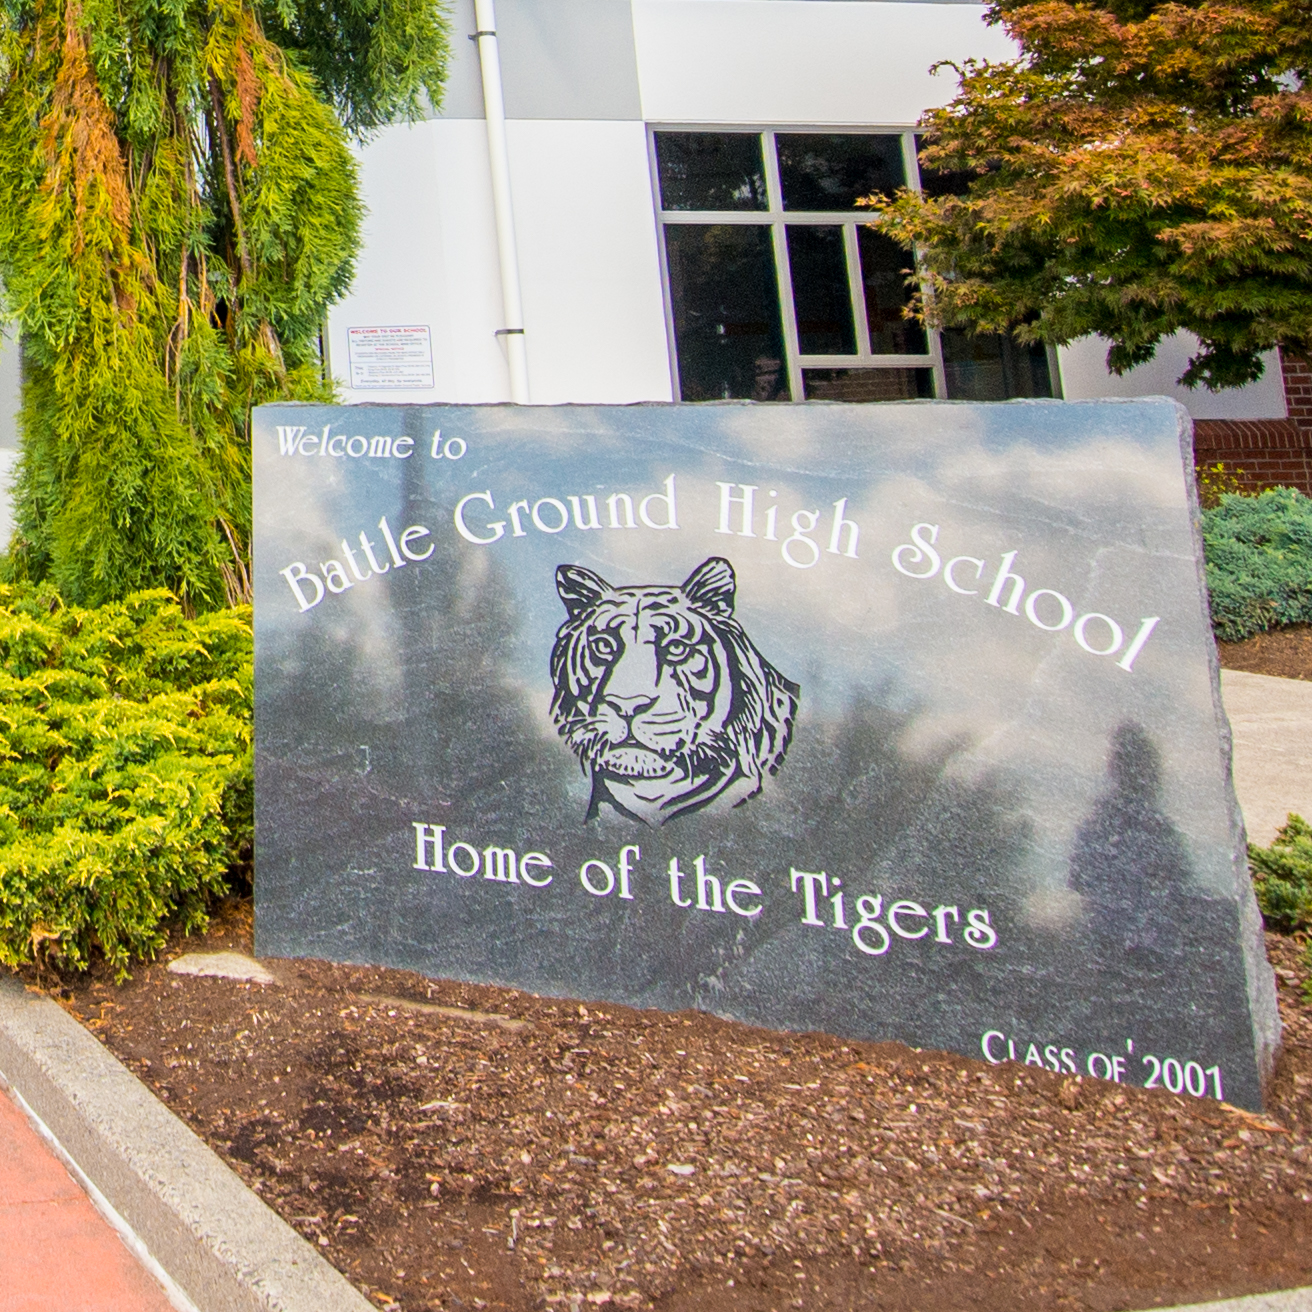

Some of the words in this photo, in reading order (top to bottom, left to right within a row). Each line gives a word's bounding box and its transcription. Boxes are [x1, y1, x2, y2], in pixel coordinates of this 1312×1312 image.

[276, 424, 415, 459] Welcome
[430, 429, 468, 460] to
[279, 515, 436, 614] Battle
[454, 473, 681, 545] Ground
[714, 481, 861, 569] High
[891, 522, 1161, 673] School
[412, 821, 554, 888] Home
[580, 844, 641, 901] of
[668, 854, 763, 917] the
[790, 866, 998, 956] Tigers
